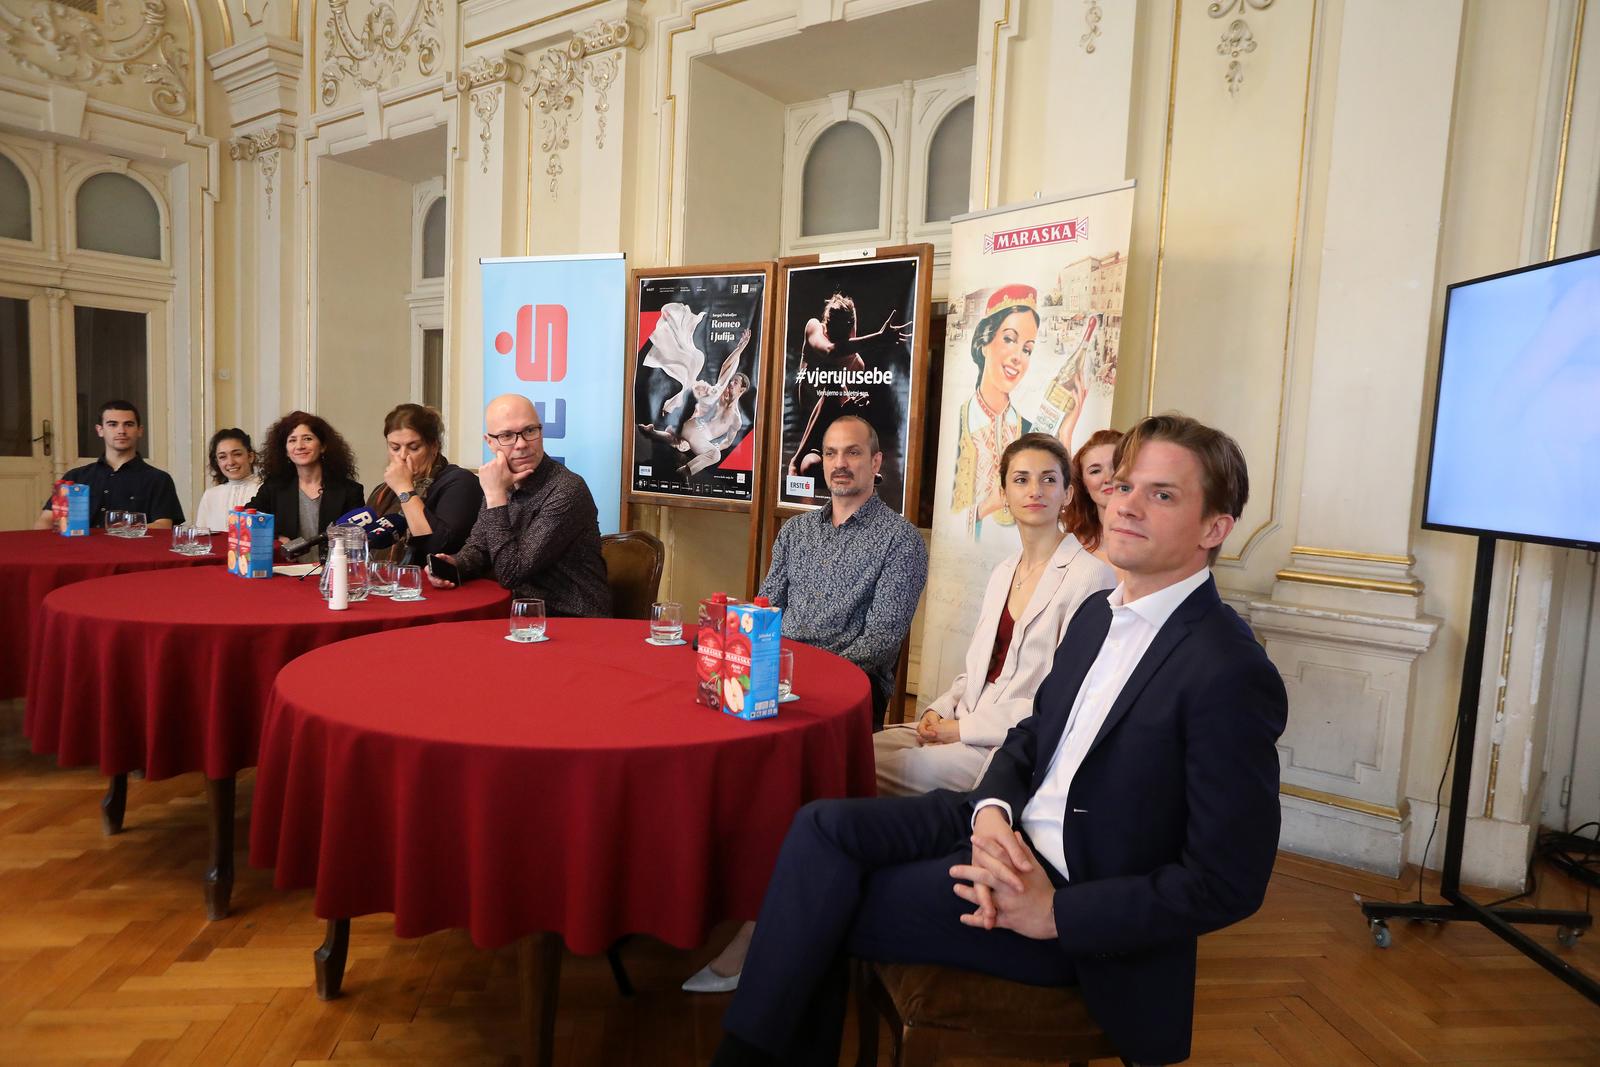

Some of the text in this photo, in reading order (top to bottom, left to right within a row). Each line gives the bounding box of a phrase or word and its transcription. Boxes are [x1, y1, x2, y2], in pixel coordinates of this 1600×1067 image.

[997, 224, 1072, 248] MARASKA
[711, 319, 741, 328] Romeo
[710, 331, 735, 343] i Julija
[796, 367, 892, 387] #vjerujusebe
